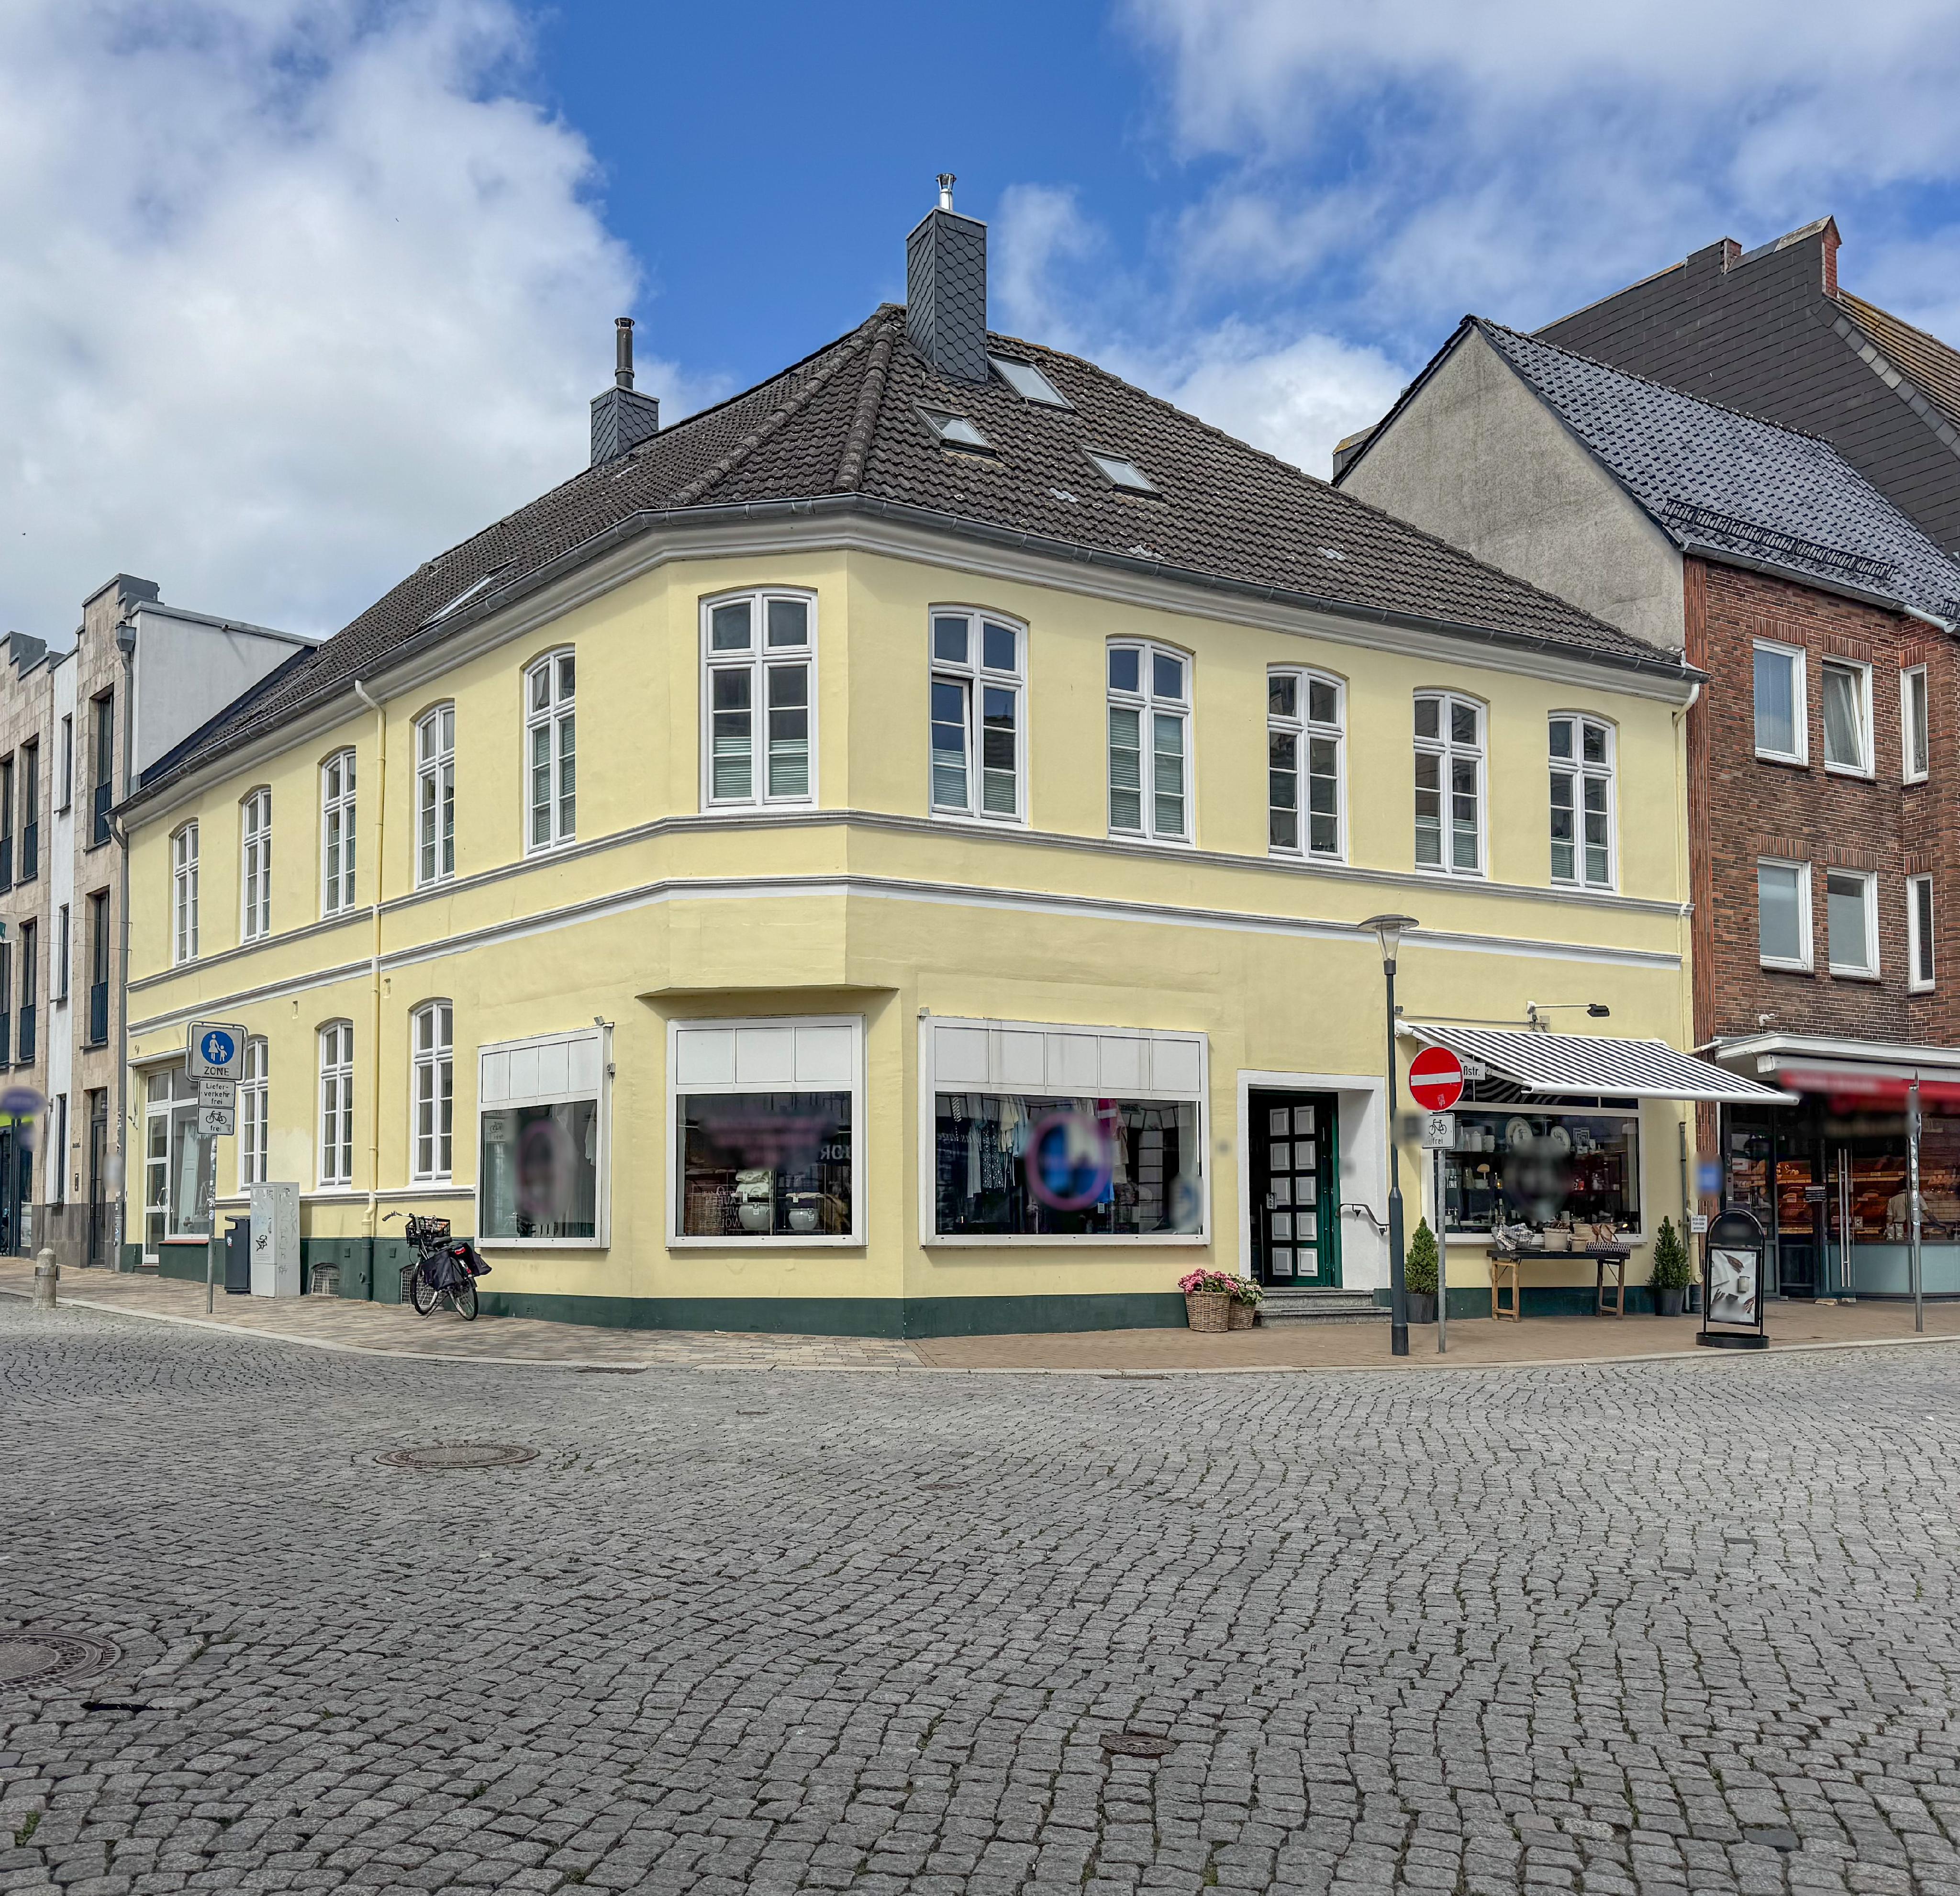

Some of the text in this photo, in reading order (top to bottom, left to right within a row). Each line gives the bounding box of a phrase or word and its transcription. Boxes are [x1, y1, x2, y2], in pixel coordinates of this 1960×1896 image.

[204, 1066, 230, 1076] ZONE
[1463, 1065, 1481, 1076] ßstr.
[1433, 1137, 1443, 1145] frei
